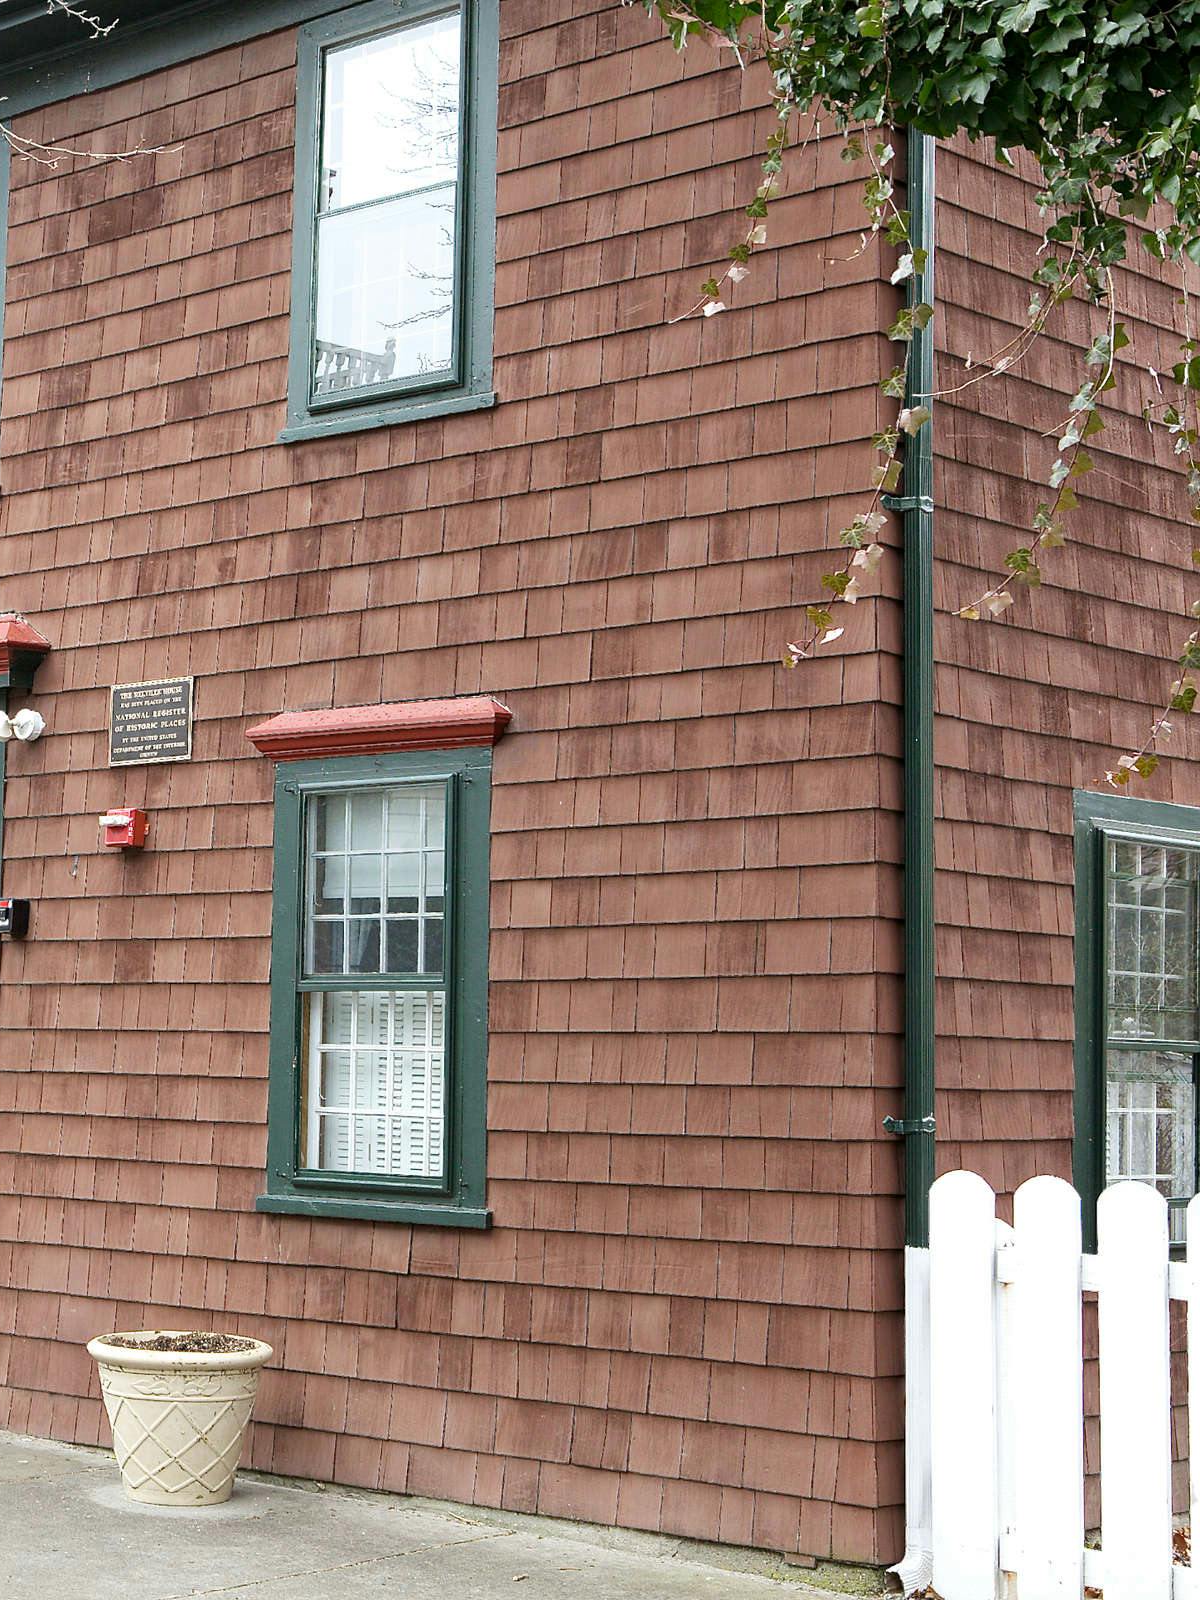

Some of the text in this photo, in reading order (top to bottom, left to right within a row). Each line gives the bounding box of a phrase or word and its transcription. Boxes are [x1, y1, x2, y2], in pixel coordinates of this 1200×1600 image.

[163, 686, 183, 694] HOUSE
[115, 708, 187, 721] NATIONAL REGISTER
[126, 722, 158, 732] HISTORIC
[160, 719, 186, 728] PLACES
